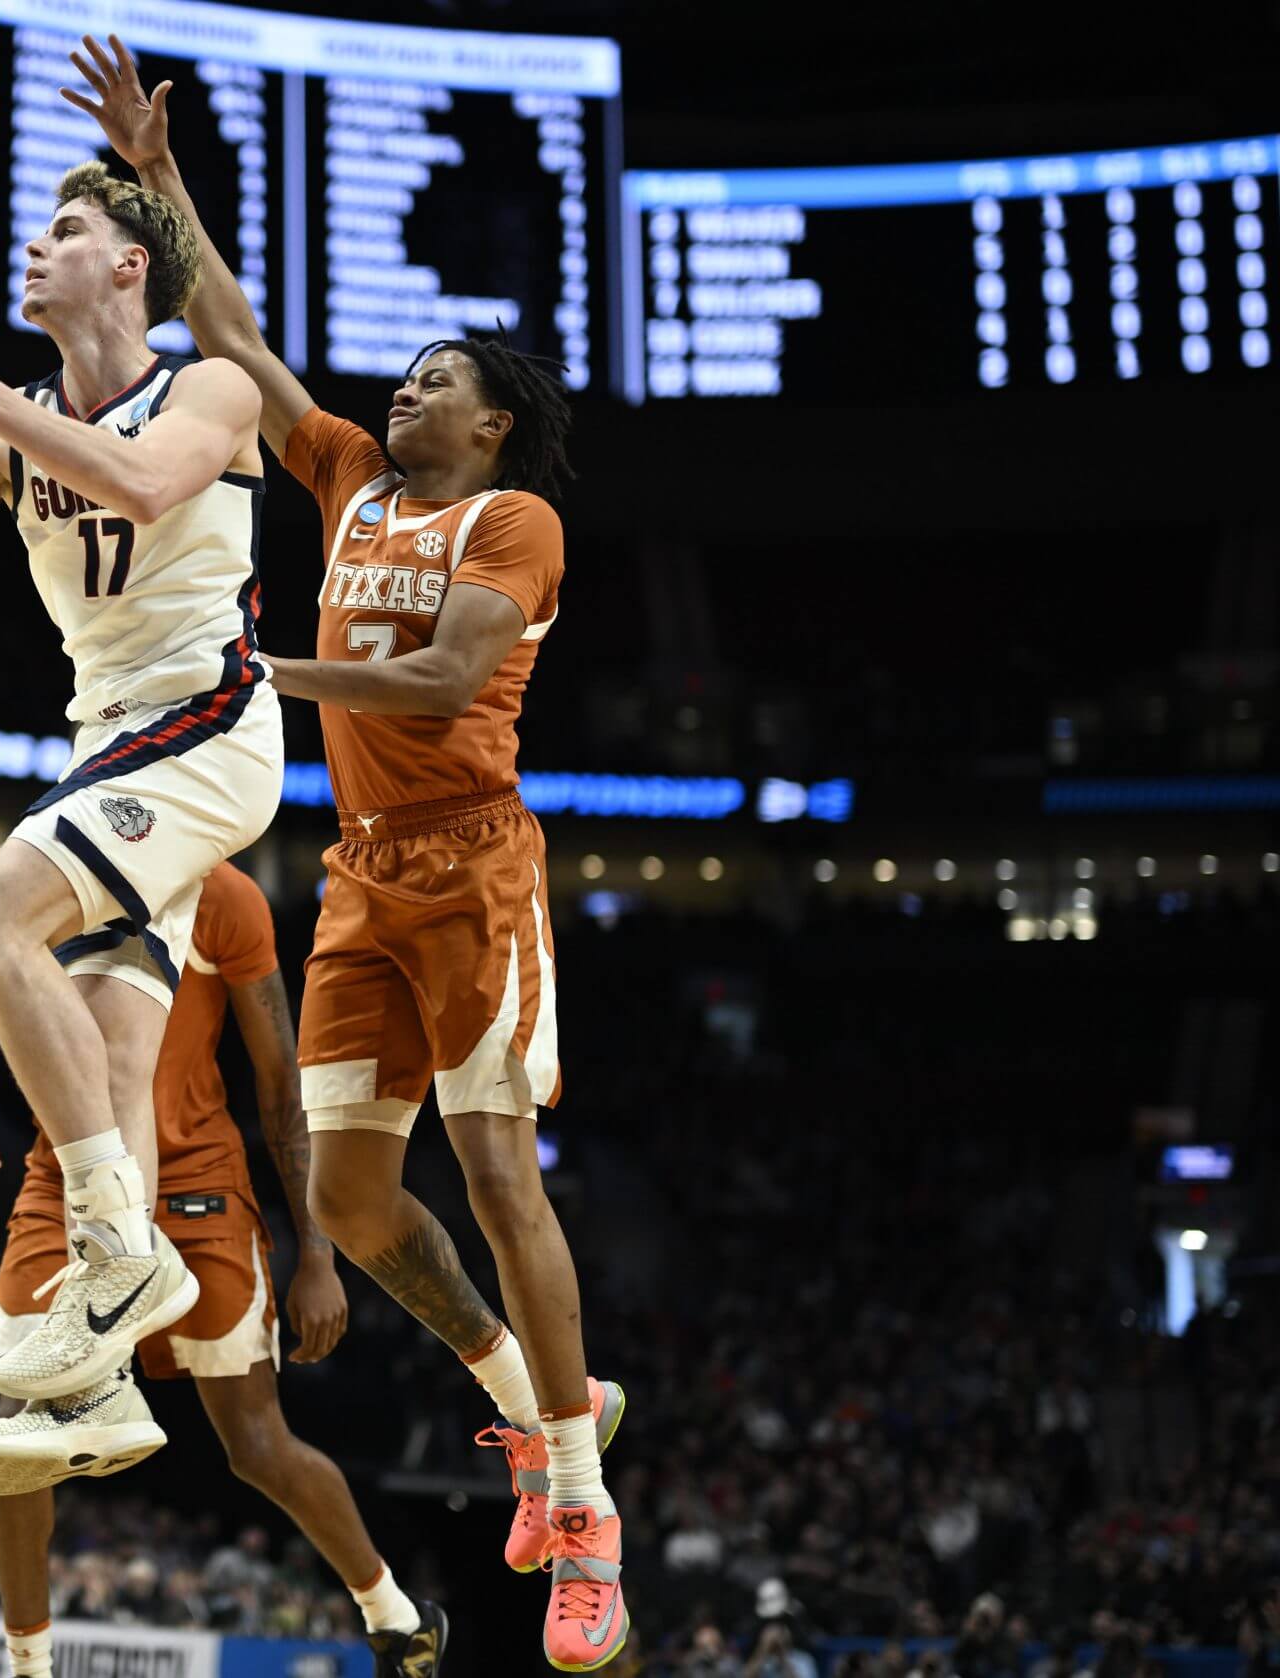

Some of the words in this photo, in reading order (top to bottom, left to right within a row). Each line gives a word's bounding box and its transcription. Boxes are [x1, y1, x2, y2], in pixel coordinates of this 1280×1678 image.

[78, 517, 135, 597] 17
[415, 531, 445, 557] SEC
[328, 561, 450, 616] TEXAS
[347, 623, 396, 662] 7
